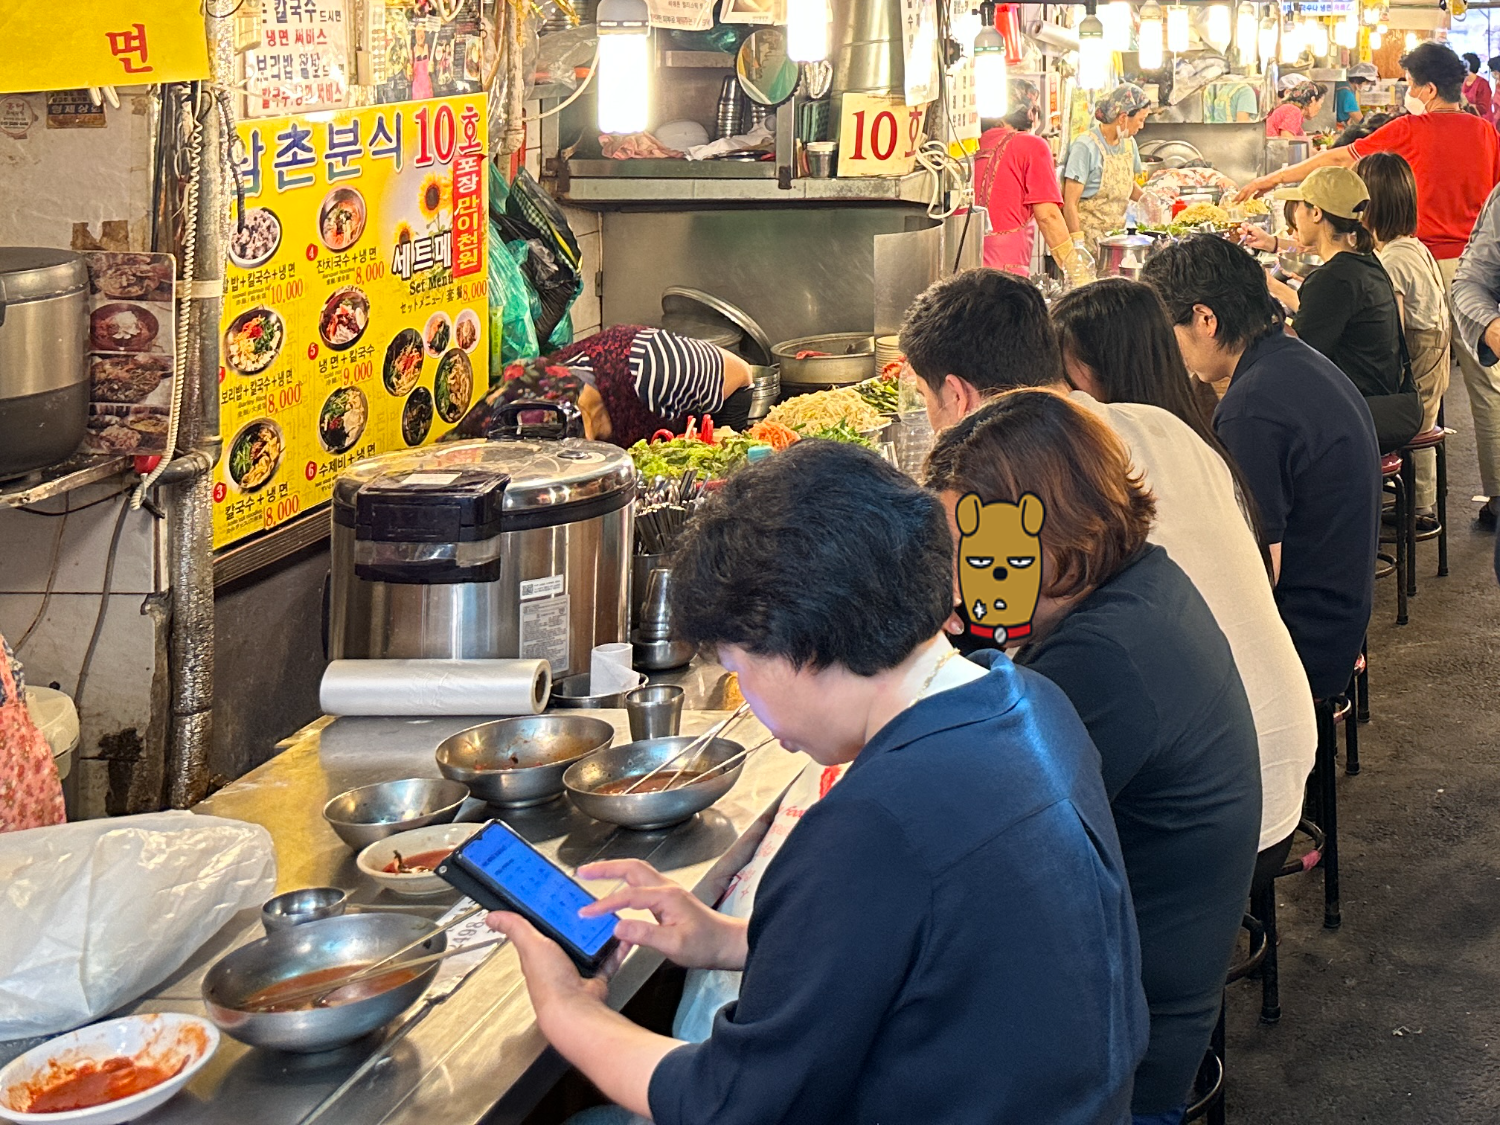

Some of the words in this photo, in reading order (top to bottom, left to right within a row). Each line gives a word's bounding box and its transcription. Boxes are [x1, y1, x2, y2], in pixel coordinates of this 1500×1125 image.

[319, 10, 342, 23] 드시면
[266, 29, 290, 47] 냉면
[414, 106, 456, 166] 10
[459, 106, 482, 154] 호
[850, 109, 898, 161] 10
[456, 158, 479, 192] 포장
[457, 194, 479, 270] 만이천원
[409, 278, 426, 295] Set
[428, 274, 454, 291] Menu
[221, 369, 293, 406] 보리밥+칼국수+냉면
